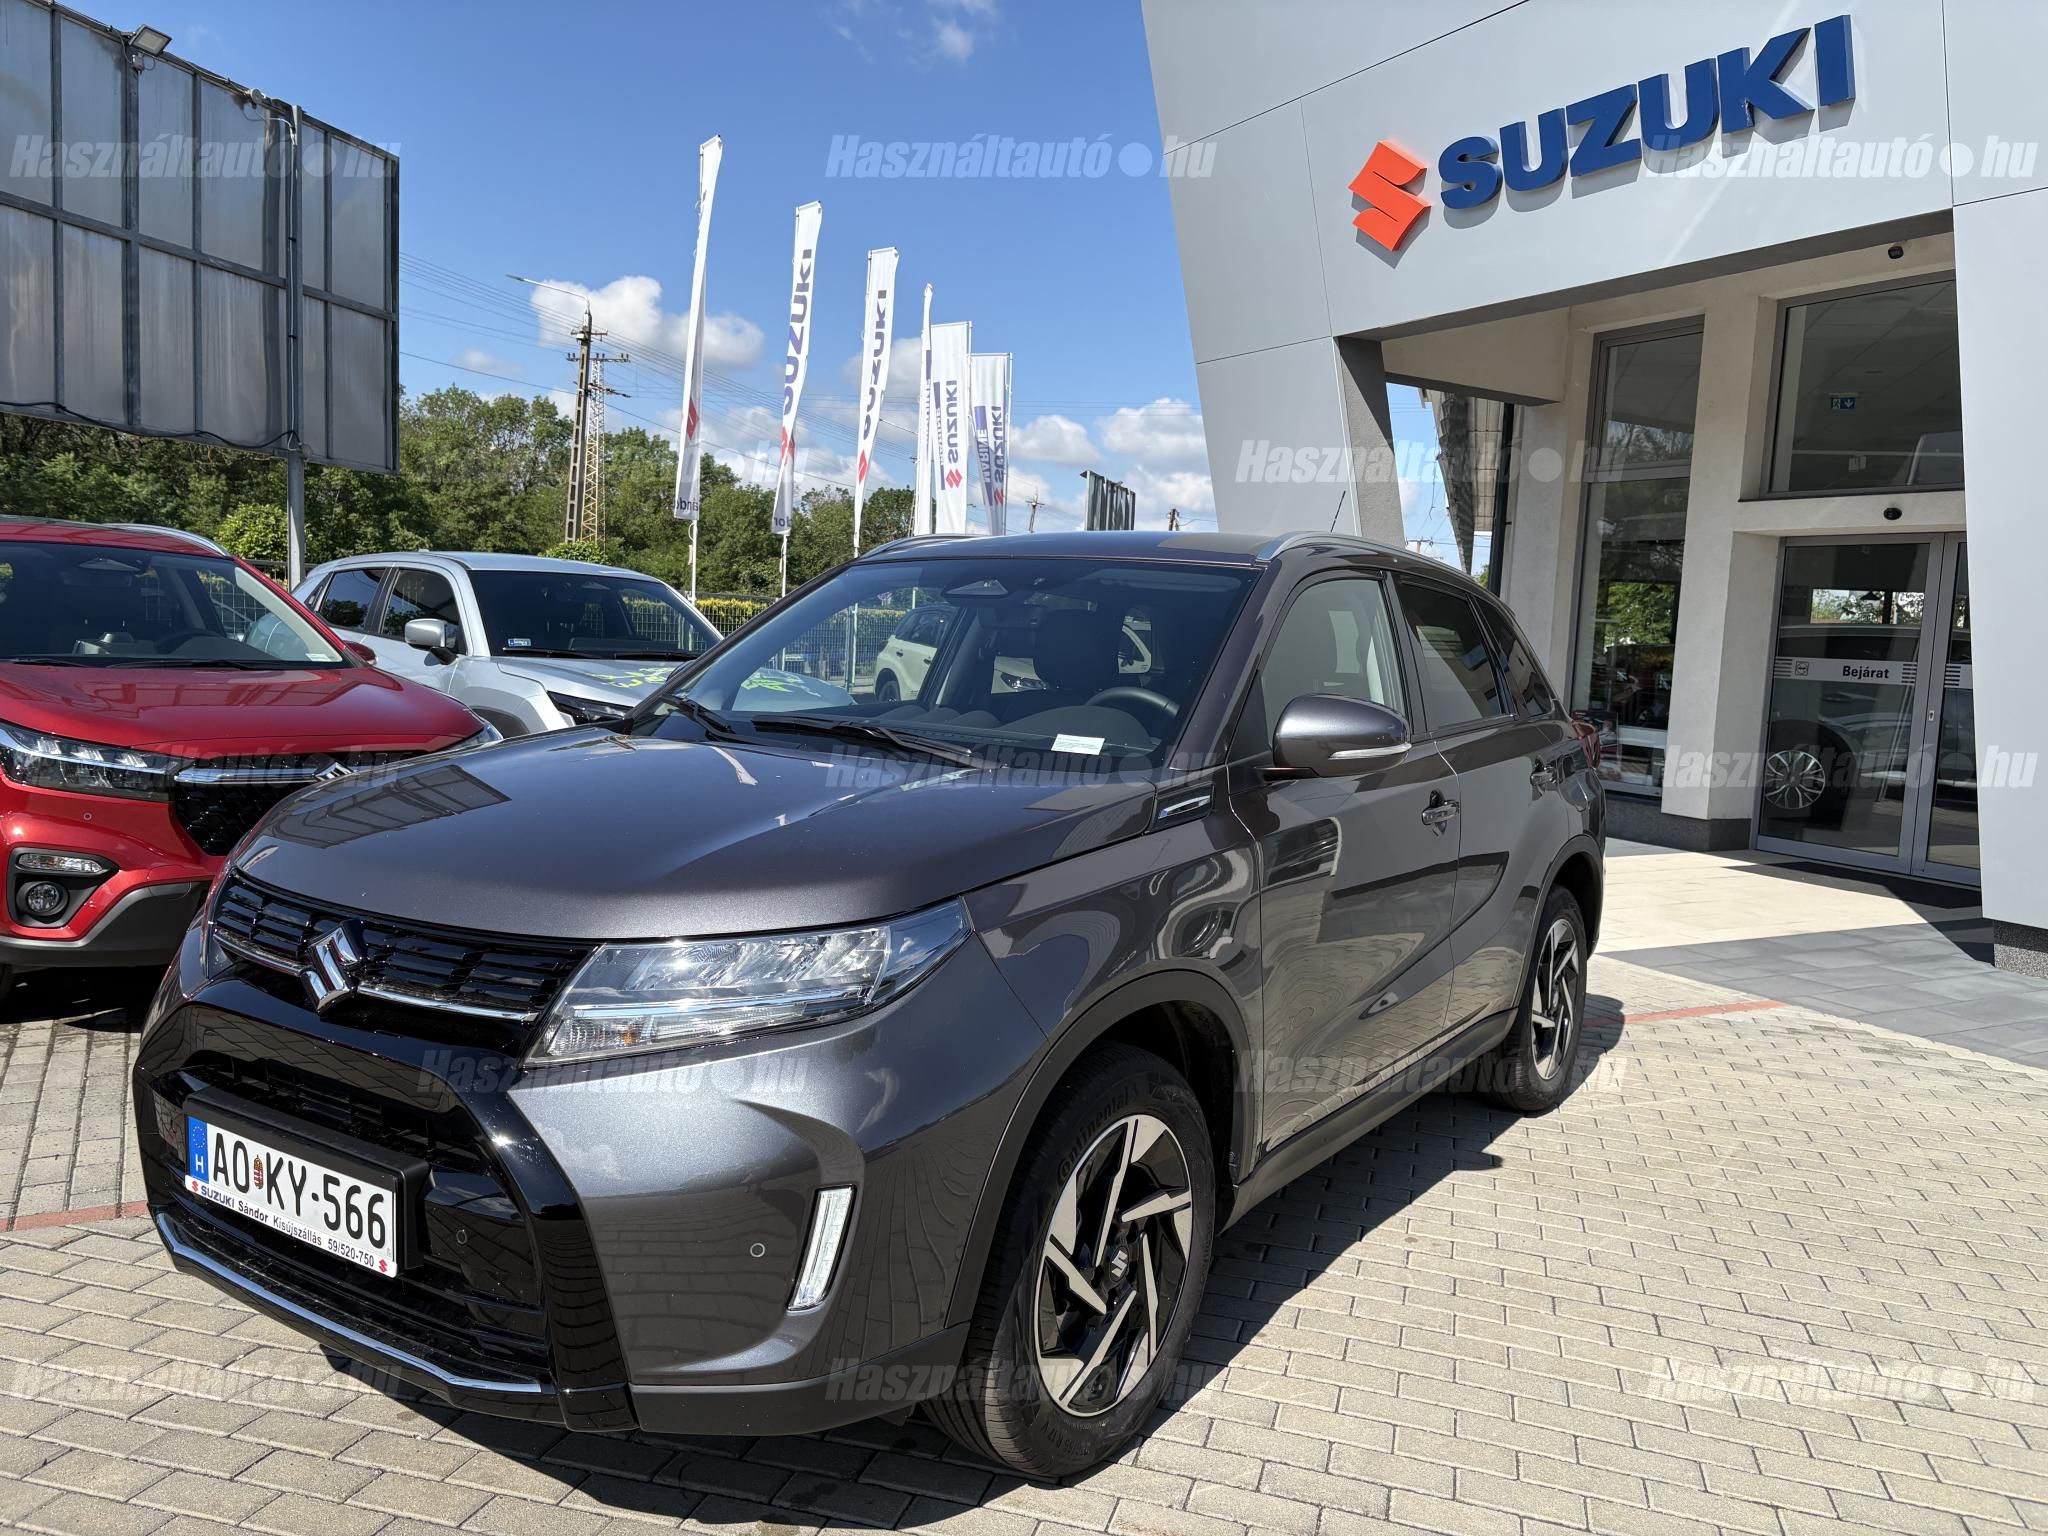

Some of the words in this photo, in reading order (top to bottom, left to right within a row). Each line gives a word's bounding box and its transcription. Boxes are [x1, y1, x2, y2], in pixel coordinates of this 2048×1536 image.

[1438, 15, 1855, 209] SUZUKI
[1842, 665, 1890, 680] Bejárat
[195, 1153, 205, 1174] H
[201, 1185, 235, 1208] SUZUKI
[238, 1200, 269, 1223] Sándor
[273, 1215, 322, 1246] Kisújszállás
[327, 1238, 375, 1267] 59/520-750
